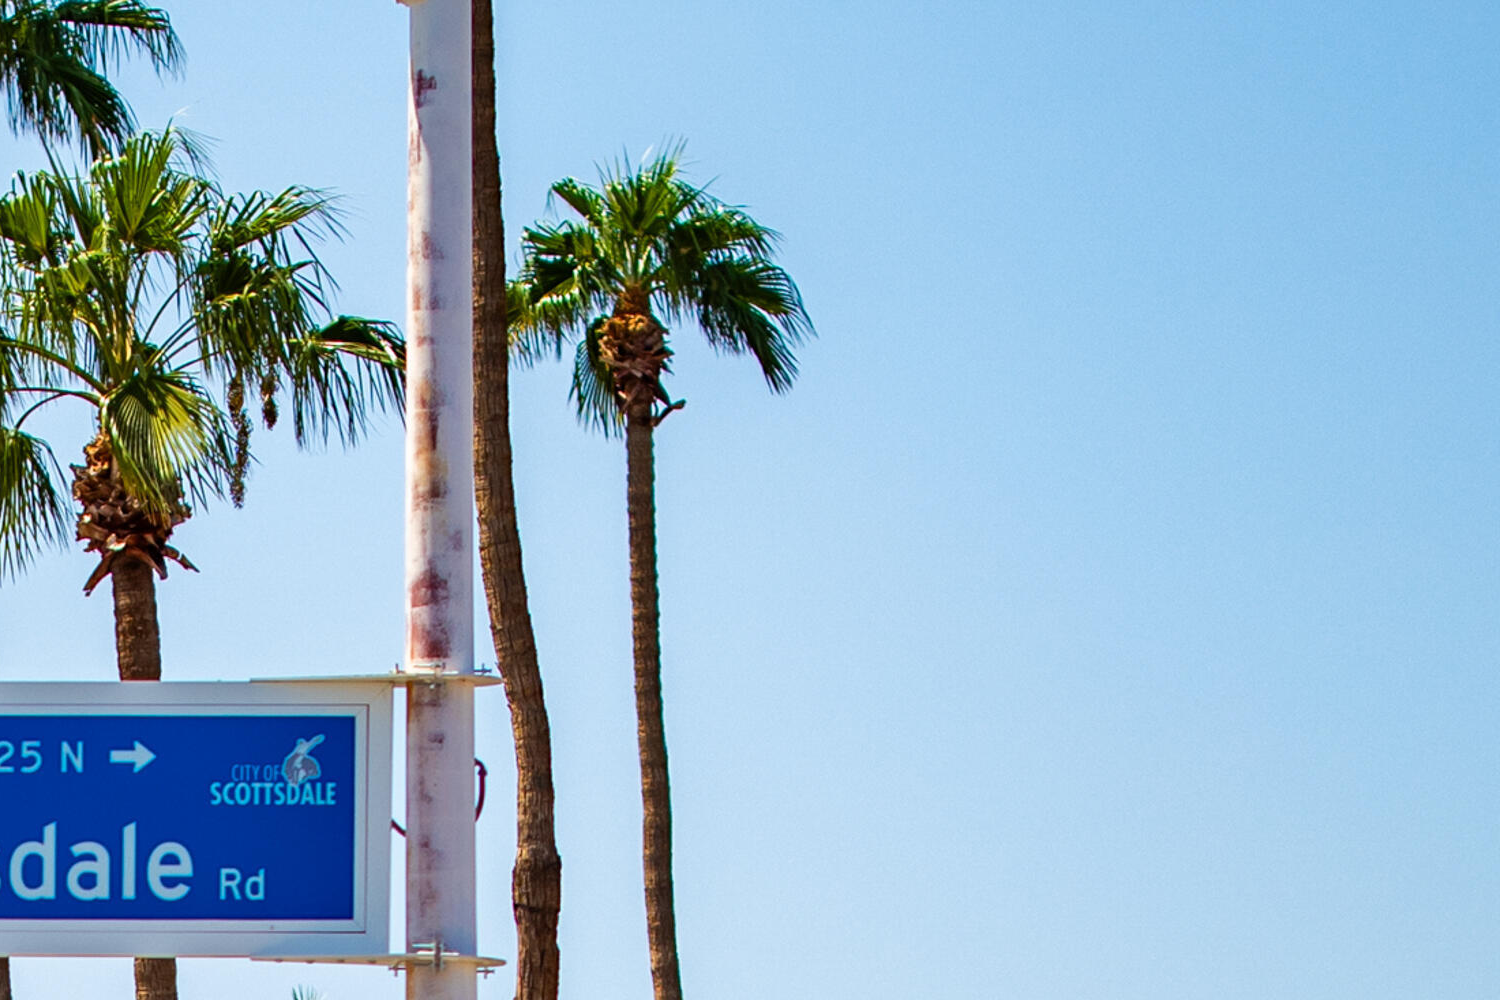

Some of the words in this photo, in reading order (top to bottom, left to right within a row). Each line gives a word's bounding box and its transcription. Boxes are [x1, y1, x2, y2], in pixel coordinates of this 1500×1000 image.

[60, 741, 84, 773] N
[230, 764, 261, 782] CITY
[263, 764, 281, 782] OF
[209, 781, 337, 806] SCOTTSDALE
[219, 868, 266, 901] Rd
